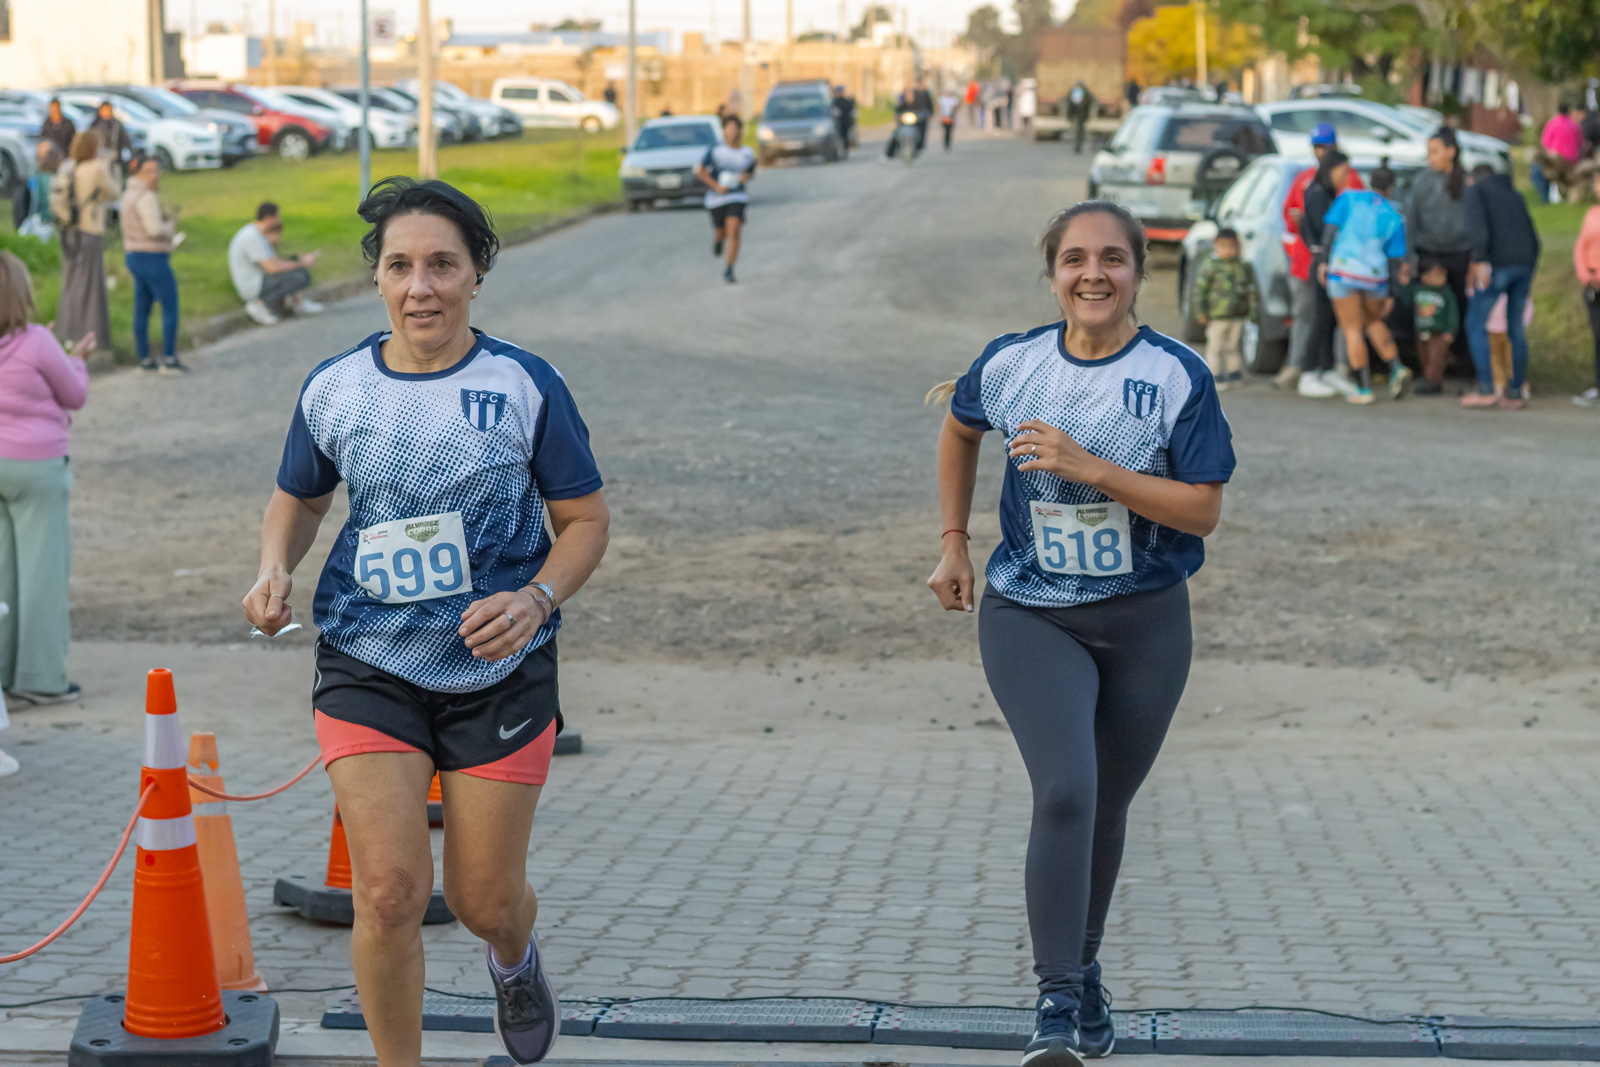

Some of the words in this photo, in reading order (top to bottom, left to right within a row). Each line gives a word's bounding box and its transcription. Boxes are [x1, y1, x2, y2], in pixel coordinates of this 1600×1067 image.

[1128, 381, 1154, 395] SFC
[468, 391, 499, 403] SFC
[407, 525, 439, 536] CORRE
[1042, 525, 1123, 572] 518
[359, 542, 464, 600] 599
